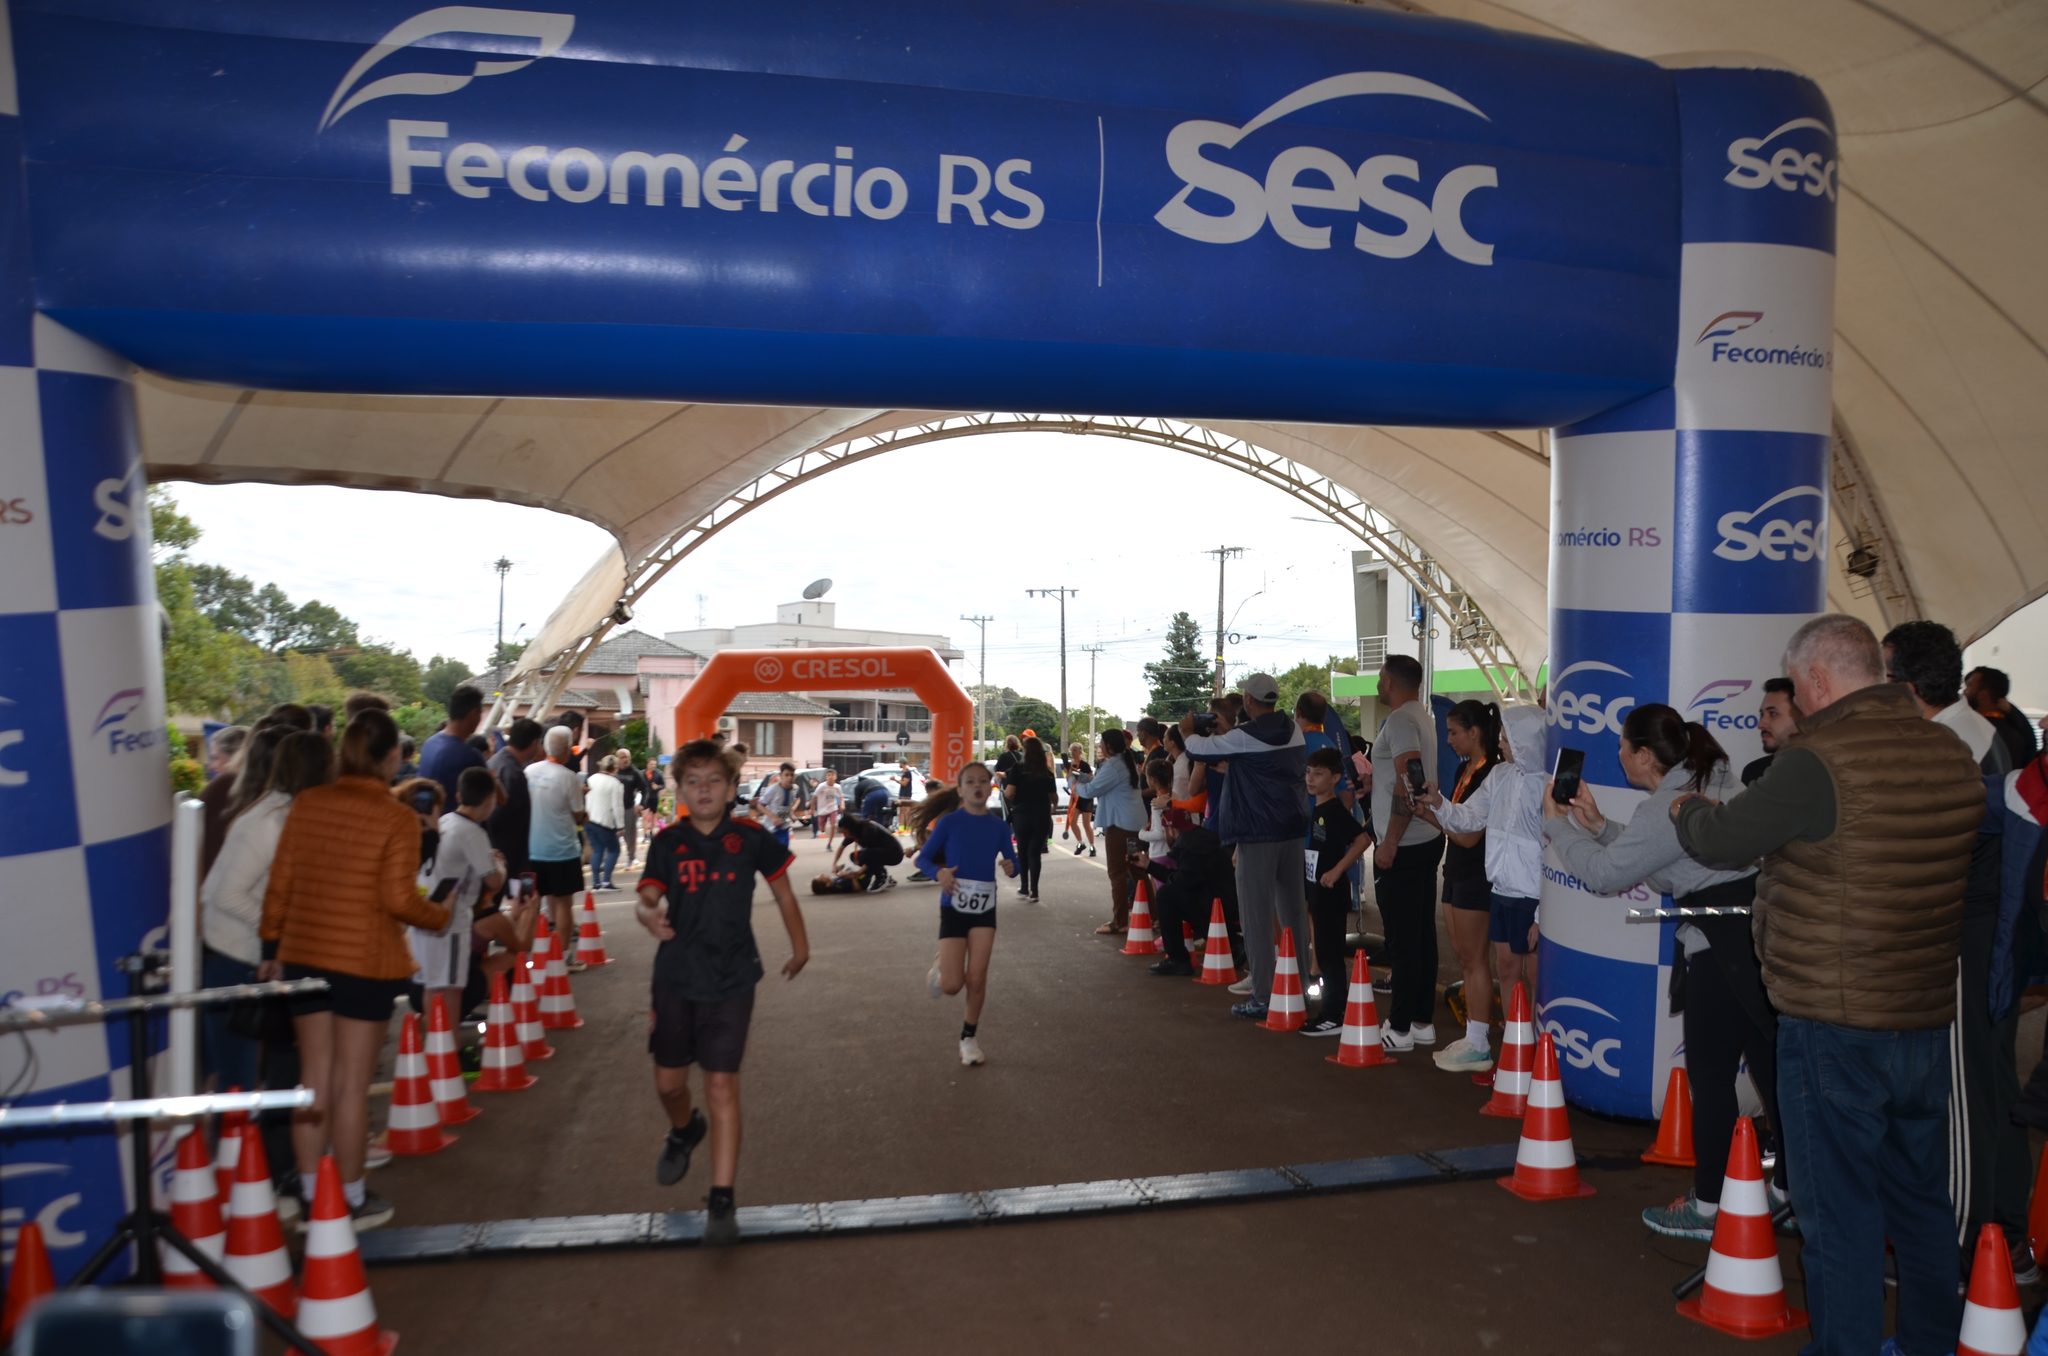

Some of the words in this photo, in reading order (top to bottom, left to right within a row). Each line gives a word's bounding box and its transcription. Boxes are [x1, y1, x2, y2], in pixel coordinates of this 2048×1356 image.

[388, 119, 908, 220] Fecomércio
[936, 154, 1045, 229] RS
[1154, 112, 1498, 266] Sesc
[1712, 342, 1824, 368] Fecomércio
[1556, 526, 1621, 547] omércio
[1629, 527, 1662, 547] RS
[792, 657, 896, 679] CRESOL
[1703, 711, 1758, 730] Feco
[958, 892, 990, 911] 967
